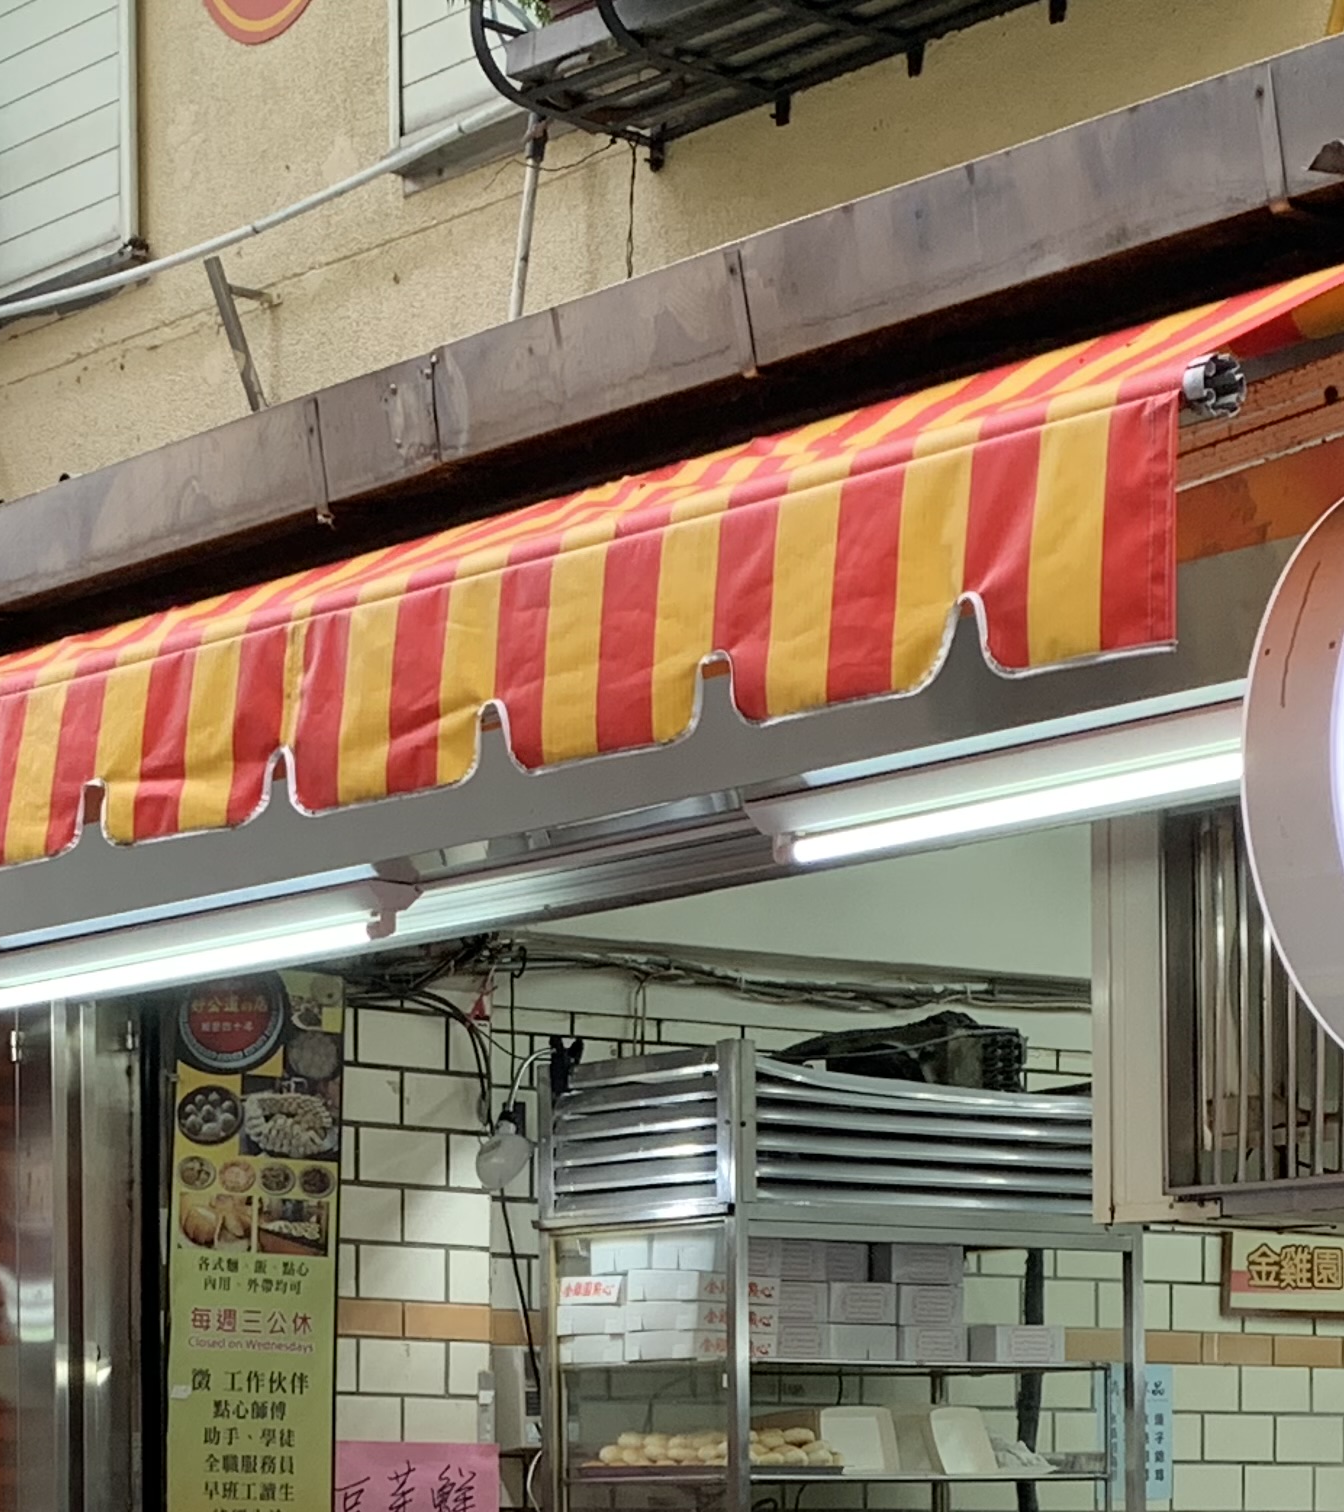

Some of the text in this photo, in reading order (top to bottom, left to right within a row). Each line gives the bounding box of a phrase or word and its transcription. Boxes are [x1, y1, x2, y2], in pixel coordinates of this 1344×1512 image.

[1246, 1243, 1344, 1290] 金雞園
[191, 1307, 313, 1335] 每週三公休
[188, 1336, 226, 1350] Closed
